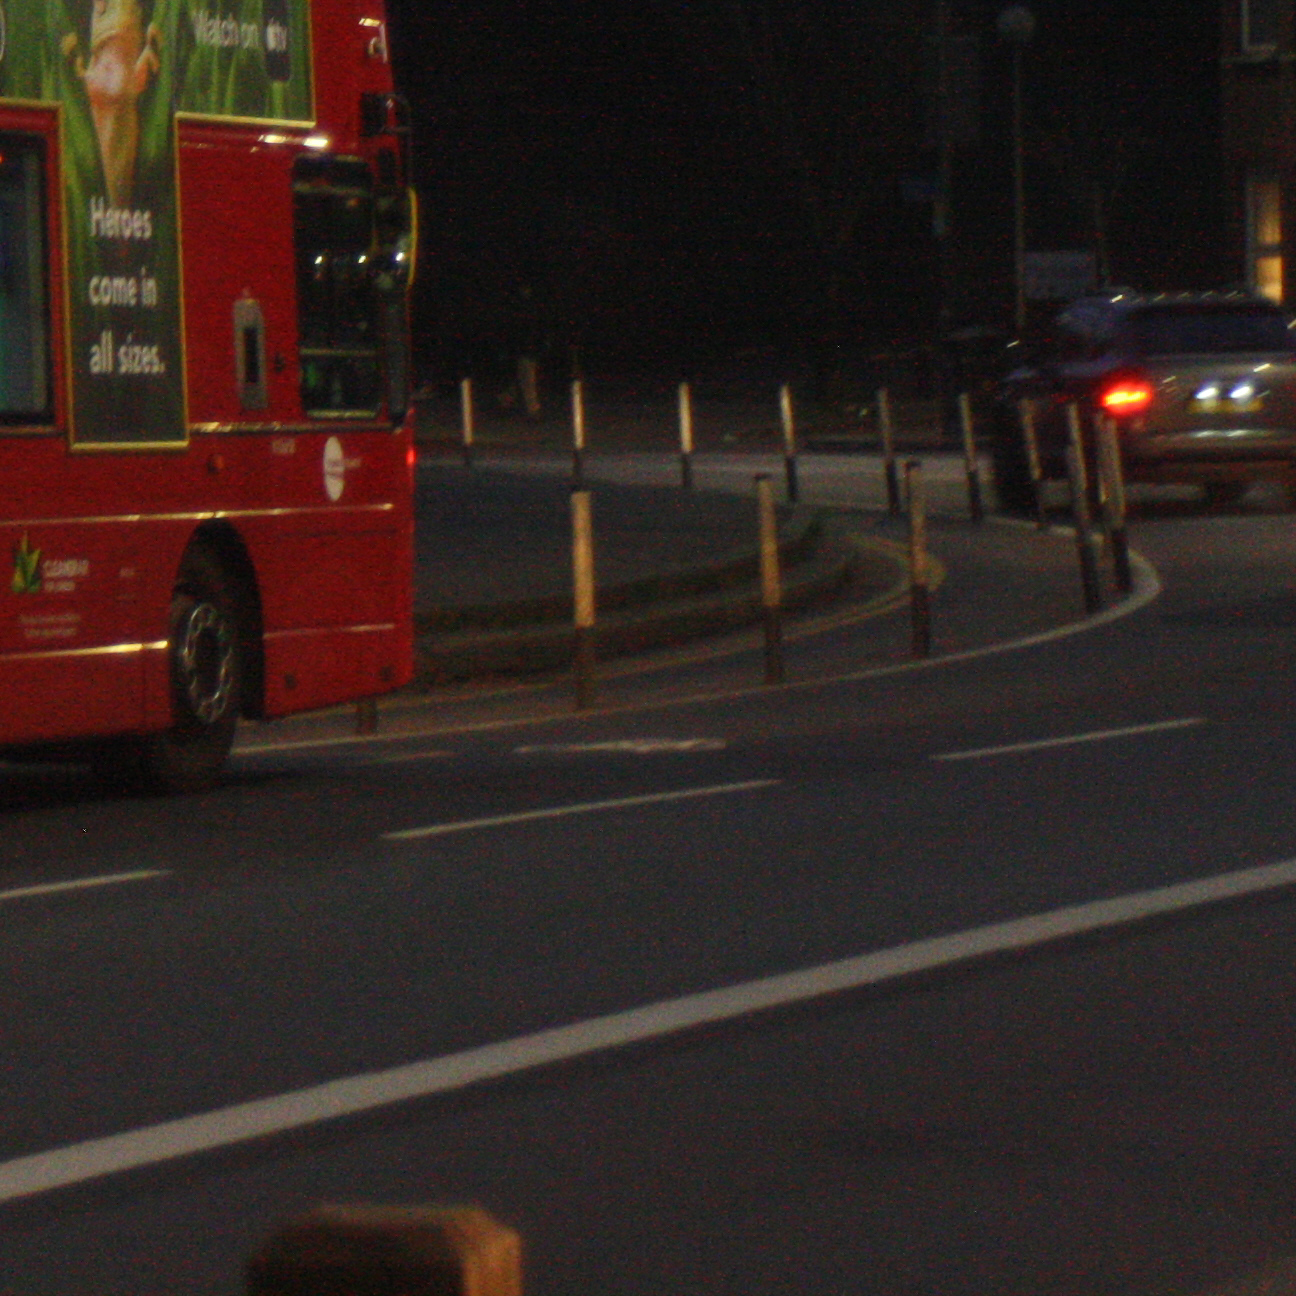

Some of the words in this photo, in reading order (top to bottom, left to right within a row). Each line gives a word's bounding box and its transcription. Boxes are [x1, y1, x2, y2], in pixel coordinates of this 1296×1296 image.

[90, 194, 153, 240] Heroes
[89, 275, 138, 307] come
[141, 266, 158, 307] in
[89, 329, 114, 374] all
[118, 332, 166, 374] sizes.
